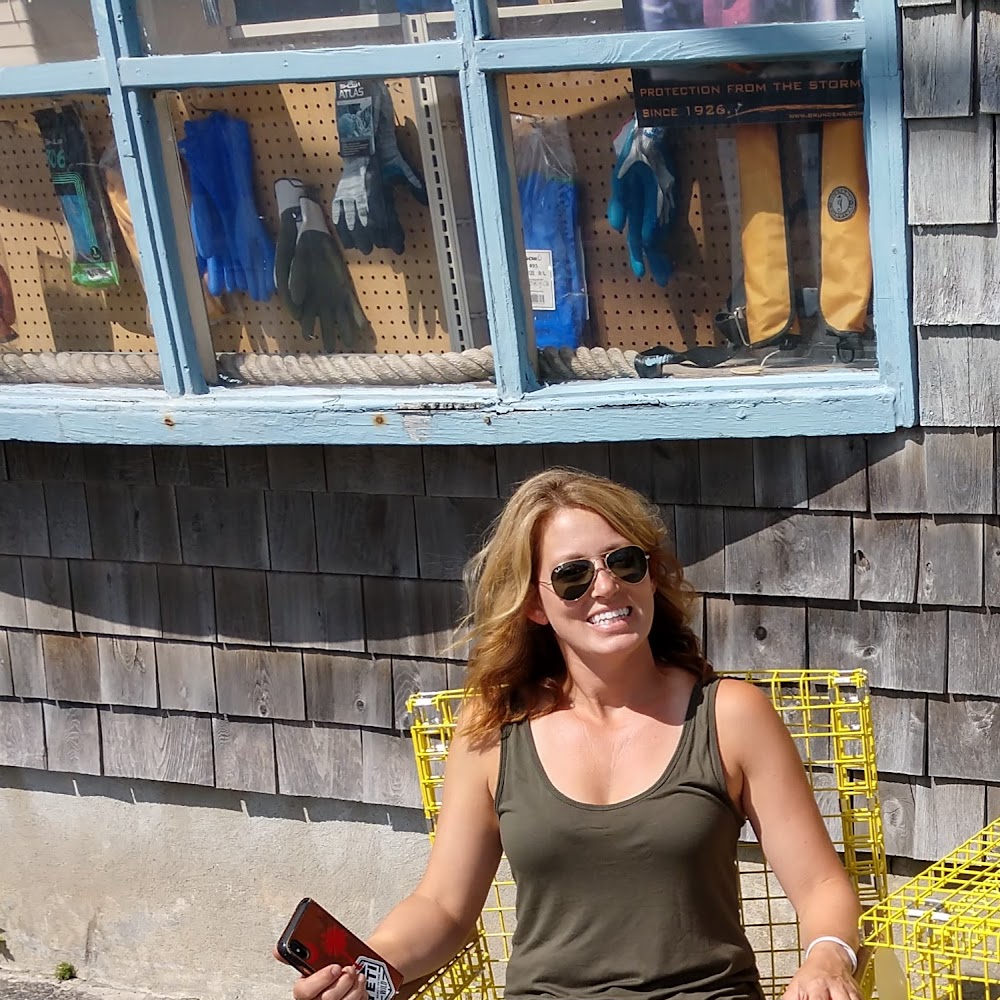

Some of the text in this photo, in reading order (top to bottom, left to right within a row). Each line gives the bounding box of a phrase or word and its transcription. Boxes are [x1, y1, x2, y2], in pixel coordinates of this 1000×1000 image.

[339, 87, 364, 99] ATLAS
[640, 79, 860, 97] PROTECTION FROM THE STORM
[642, 108, 679, 118] SINCE
